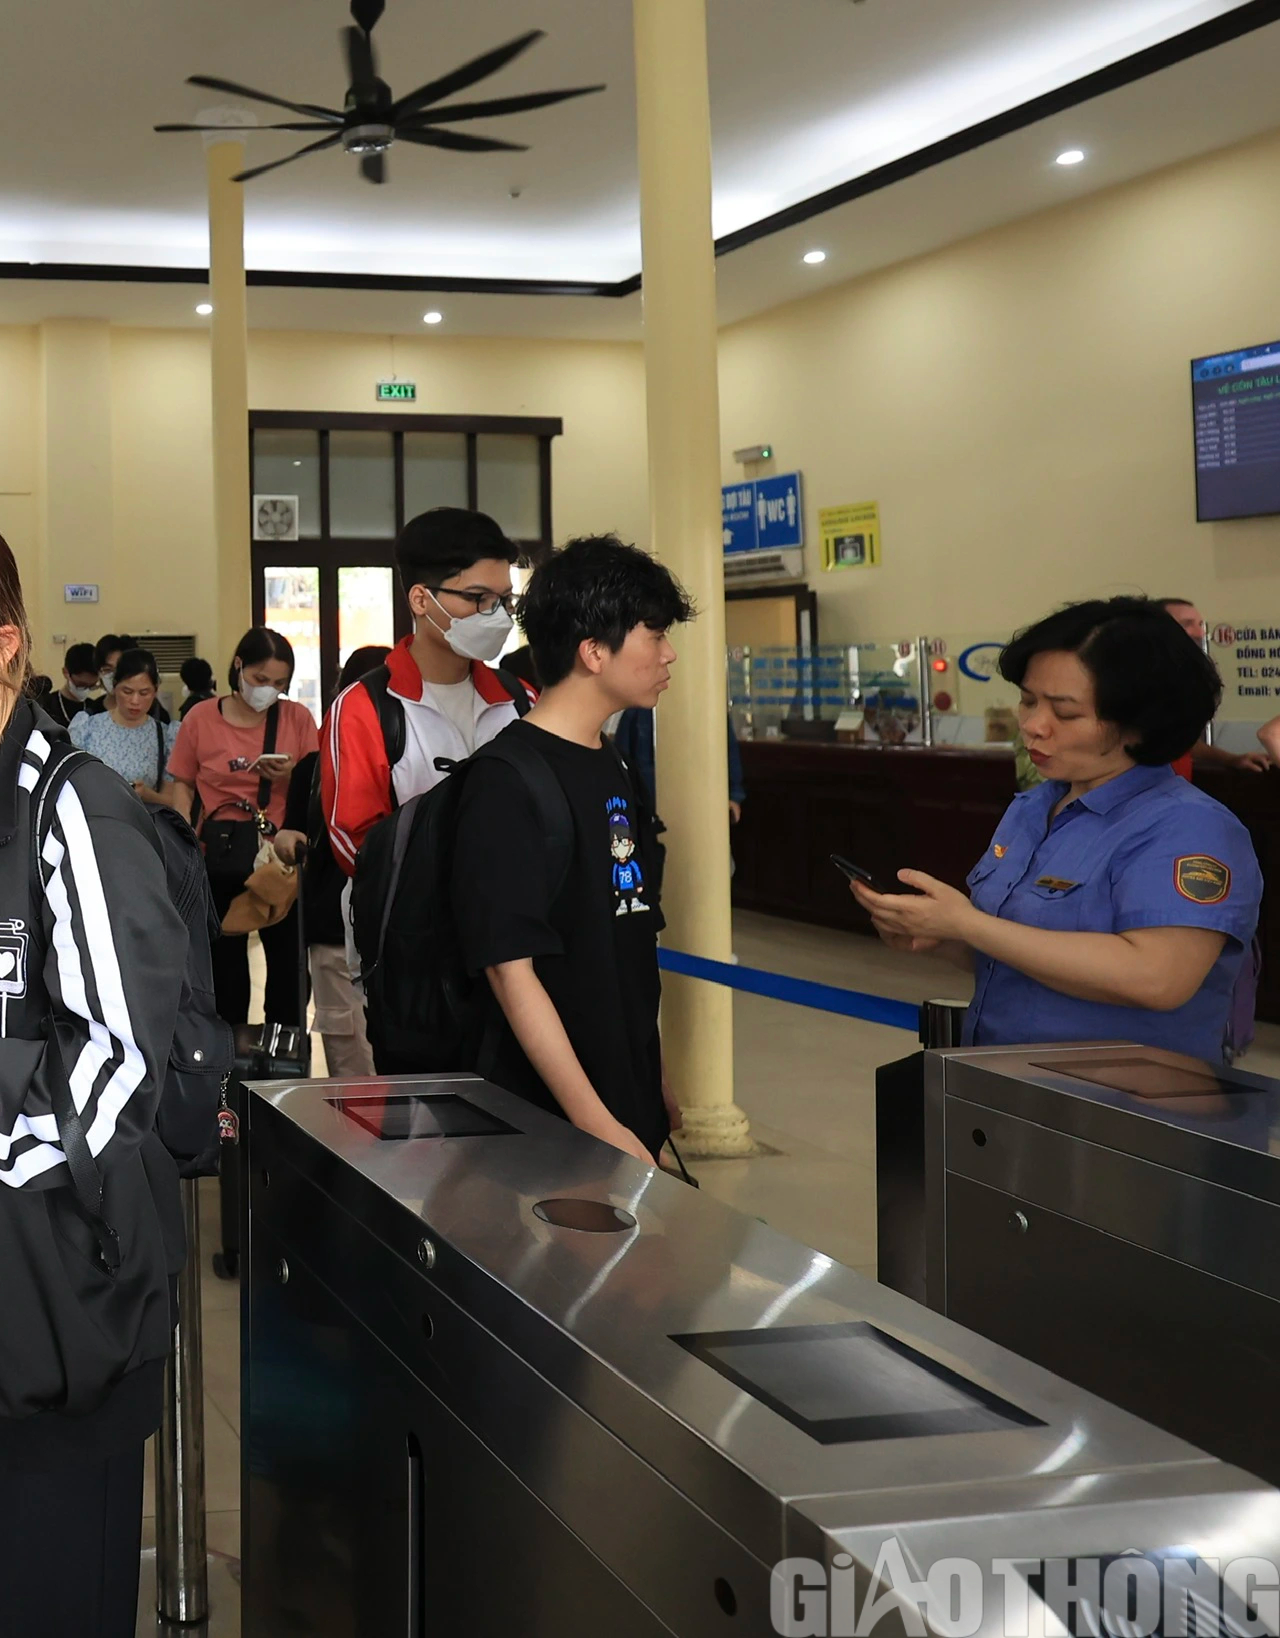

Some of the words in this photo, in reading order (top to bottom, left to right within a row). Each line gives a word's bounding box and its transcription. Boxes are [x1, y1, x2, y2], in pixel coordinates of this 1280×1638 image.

[380, 385, 414, 398] EXIT
[767, 497, 786, 522] WC
[1238, 685, 1271, 696] Email:
[619, 870, 633, 884] 78
